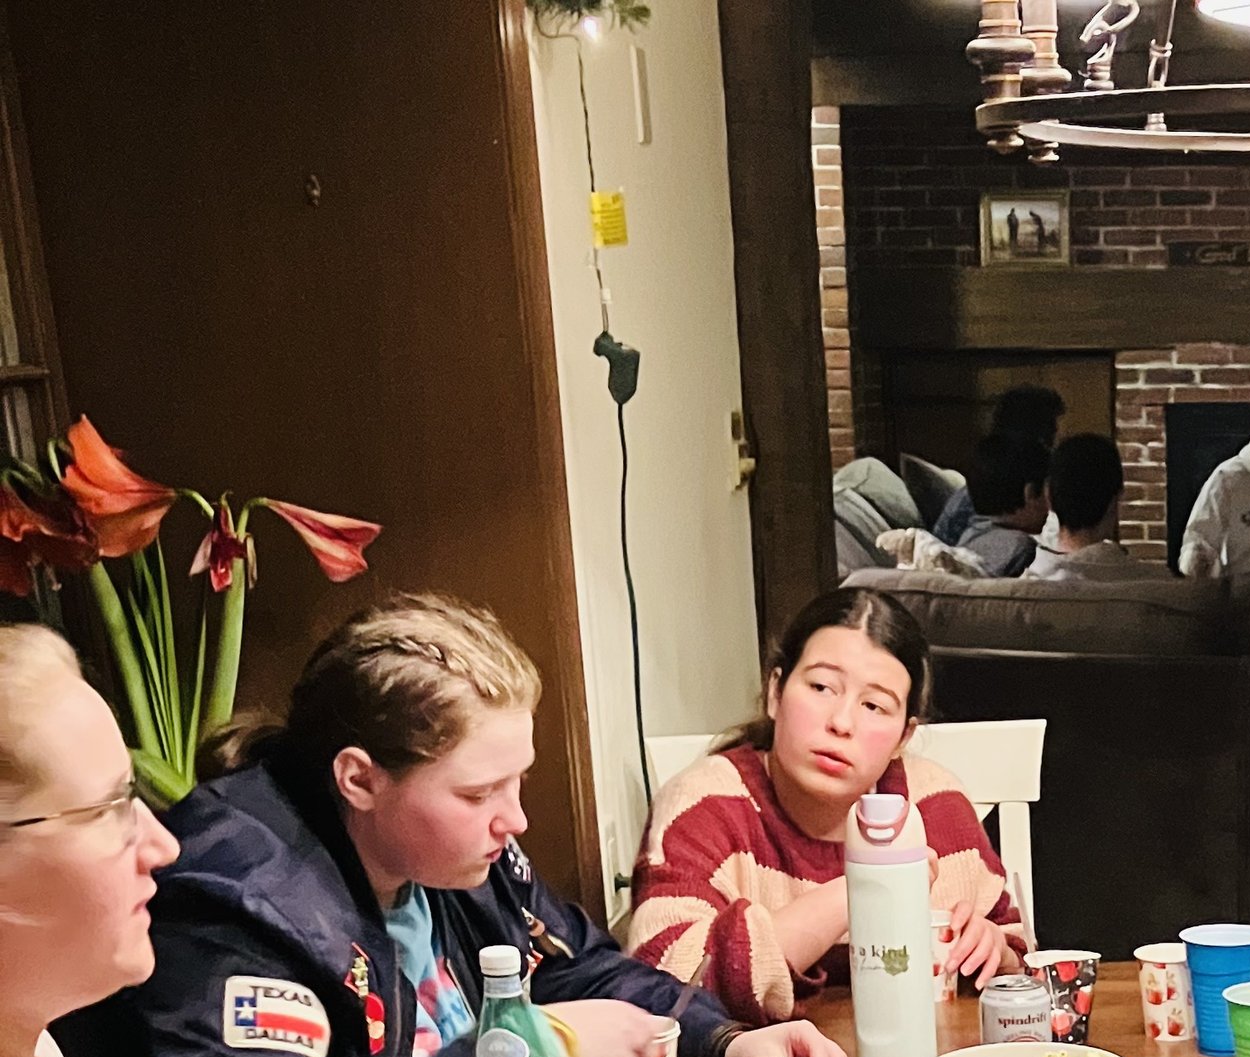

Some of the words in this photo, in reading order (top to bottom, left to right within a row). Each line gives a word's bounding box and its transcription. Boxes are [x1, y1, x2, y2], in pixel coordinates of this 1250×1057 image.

[249, 985, 312, 1007] TEXAS
[998, 1011, 1047, 1029] spindrift
[245, 1029, 314, 1049] DALLAS
